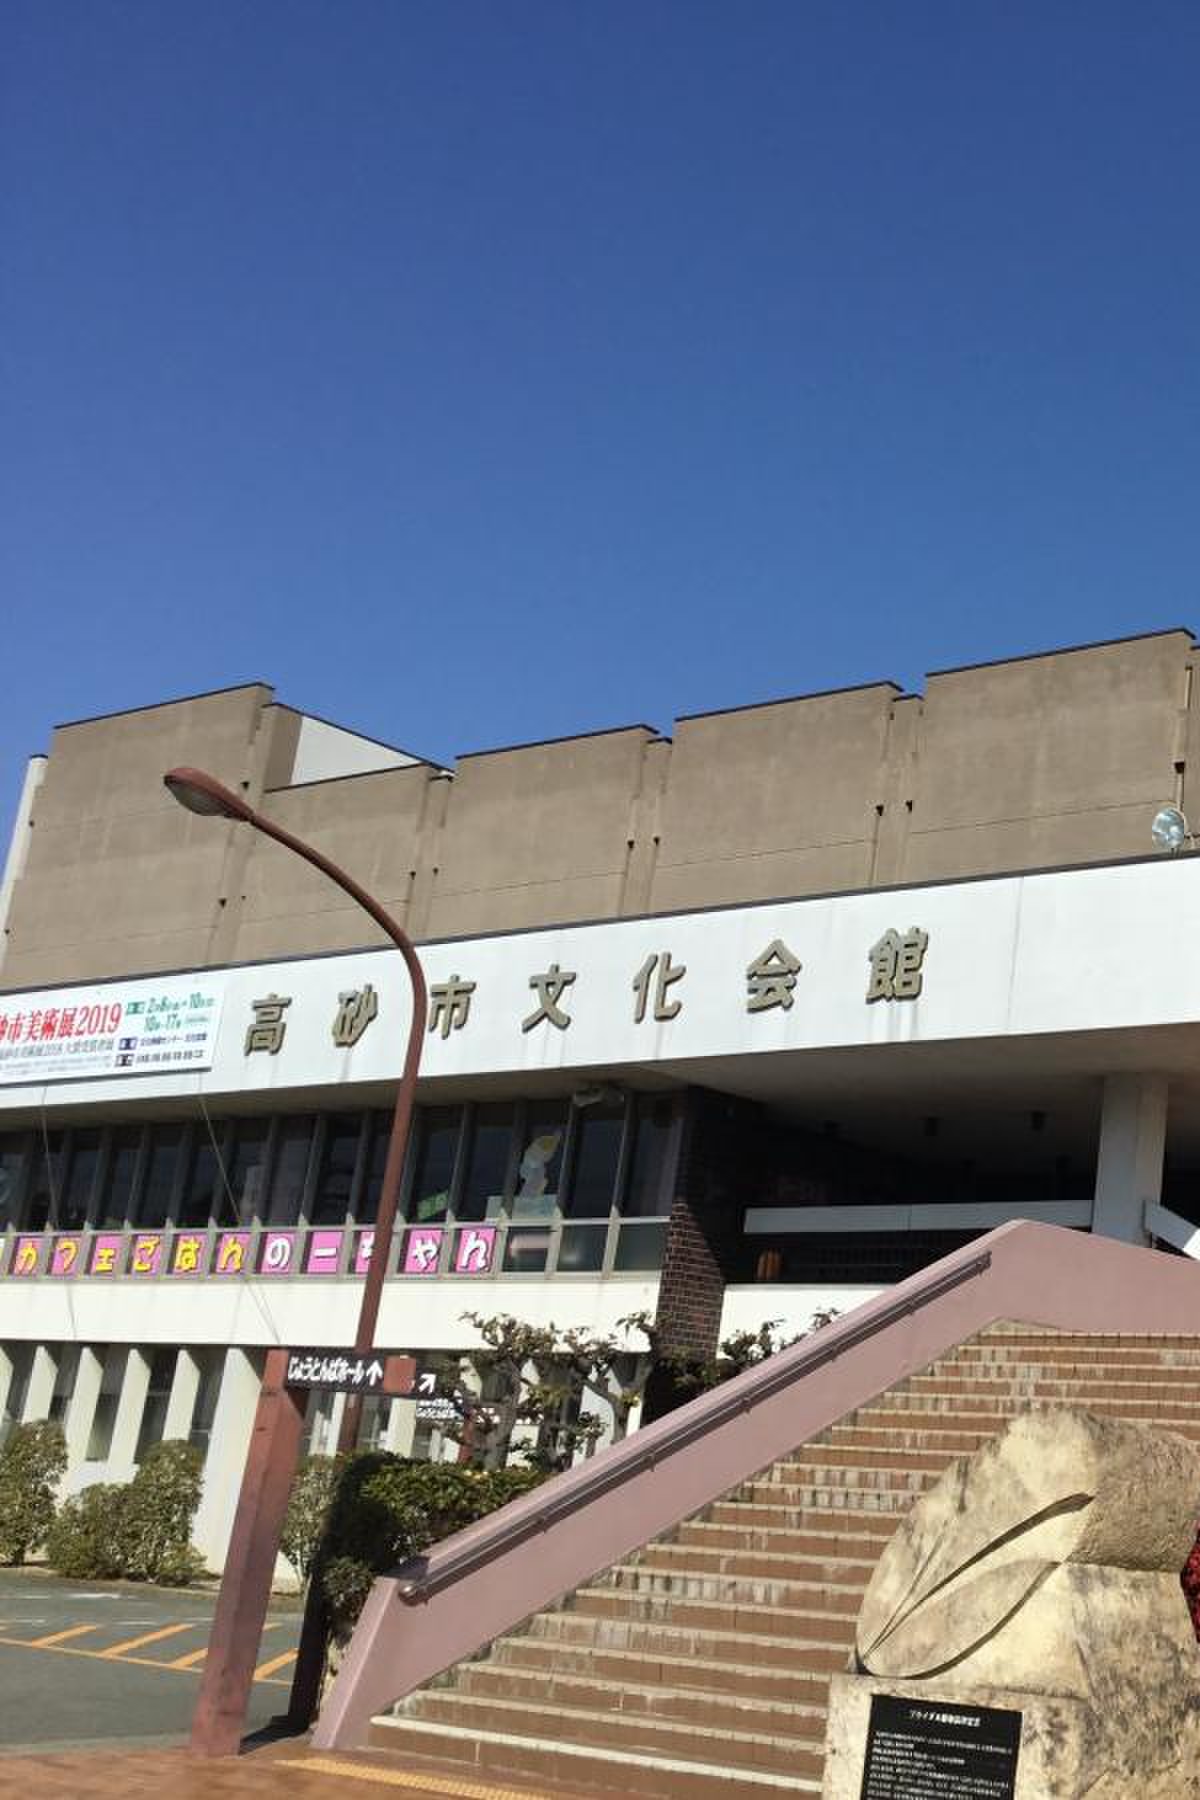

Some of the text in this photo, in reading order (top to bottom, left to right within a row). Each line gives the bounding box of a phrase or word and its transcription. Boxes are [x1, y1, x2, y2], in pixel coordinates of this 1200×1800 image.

[244, 926, 929, 1057] 高砂市文化会館
